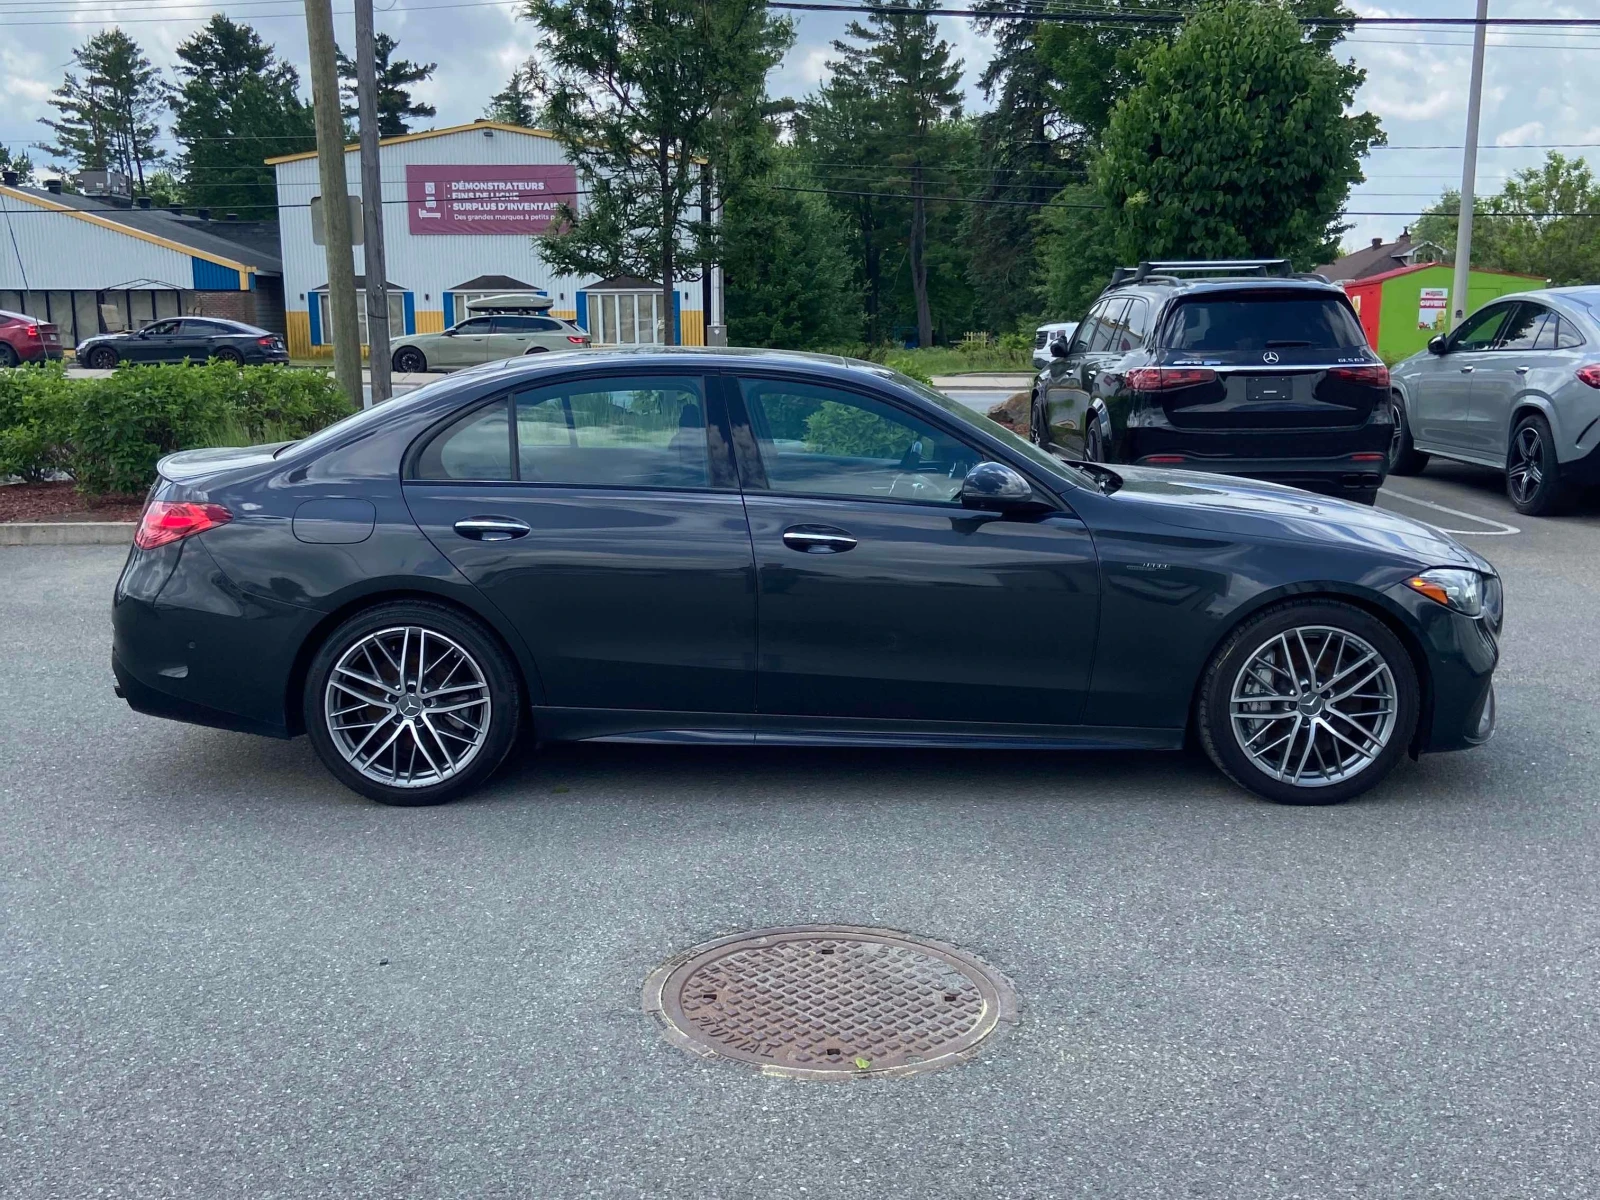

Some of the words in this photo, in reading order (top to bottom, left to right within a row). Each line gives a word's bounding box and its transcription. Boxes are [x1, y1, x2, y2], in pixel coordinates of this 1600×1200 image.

[451, 181, 544, 190] DÉMONSTRATEURS
[452, 192, 474, 200] FINS
[475, 192, 489, 200] DE
[490, 192, 519, 200] LIGNE
[453, 203, 497, 211] SURPLUS
